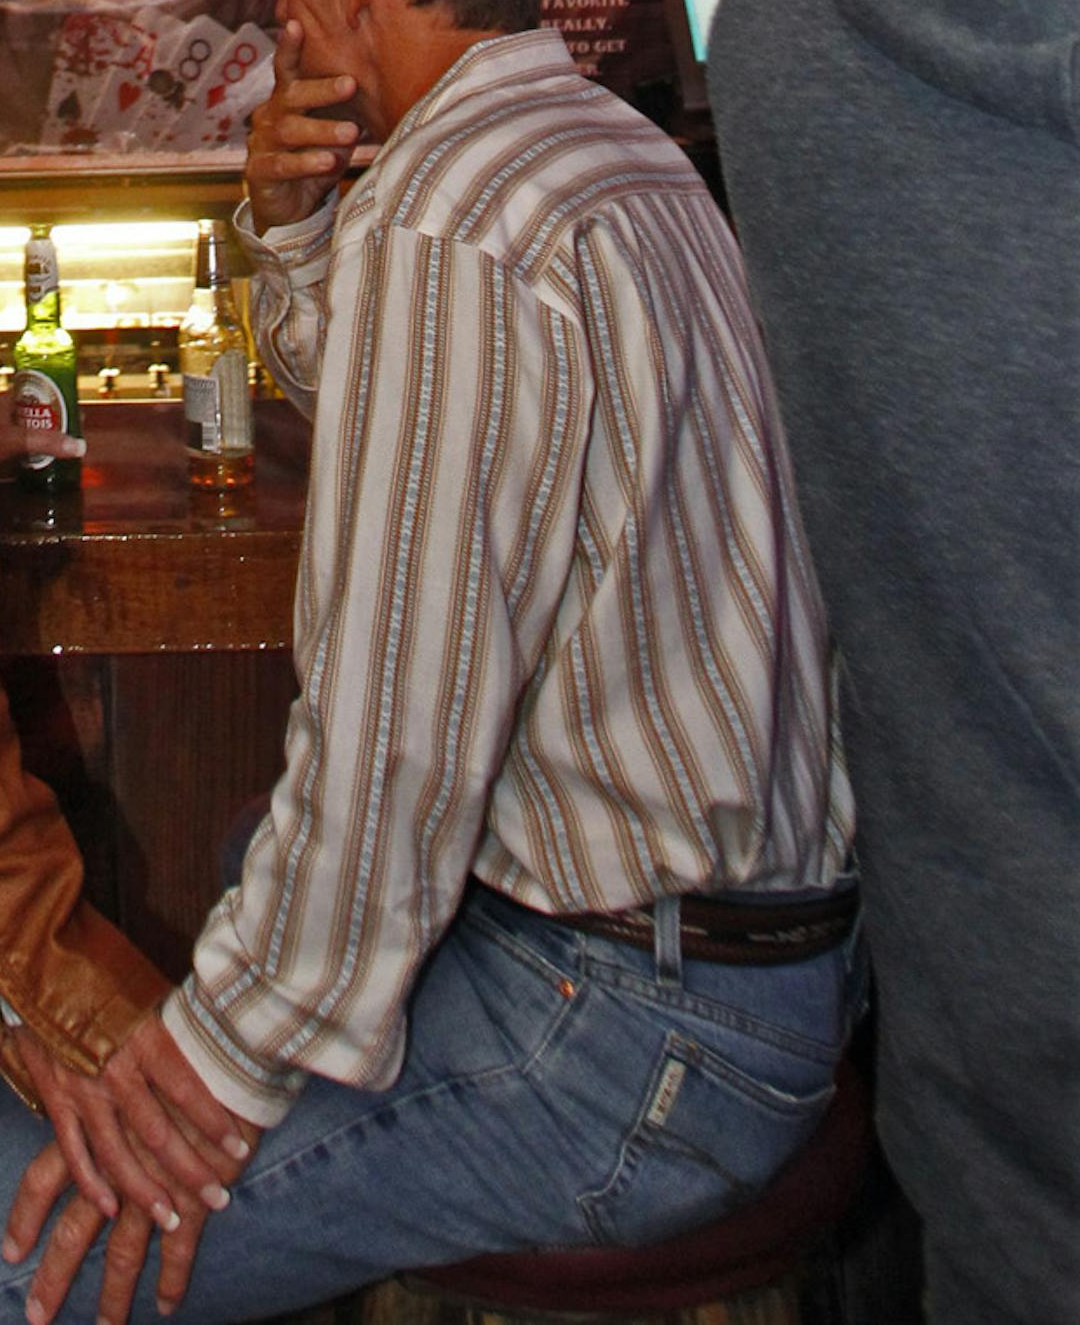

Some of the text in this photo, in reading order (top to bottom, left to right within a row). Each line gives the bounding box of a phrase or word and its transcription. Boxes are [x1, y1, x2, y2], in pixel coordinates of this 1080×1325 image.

[593, 38, 628, 53] GET
[23, 406, 52, 418] ELLA
[25, 418, 54, 430] TOIS
